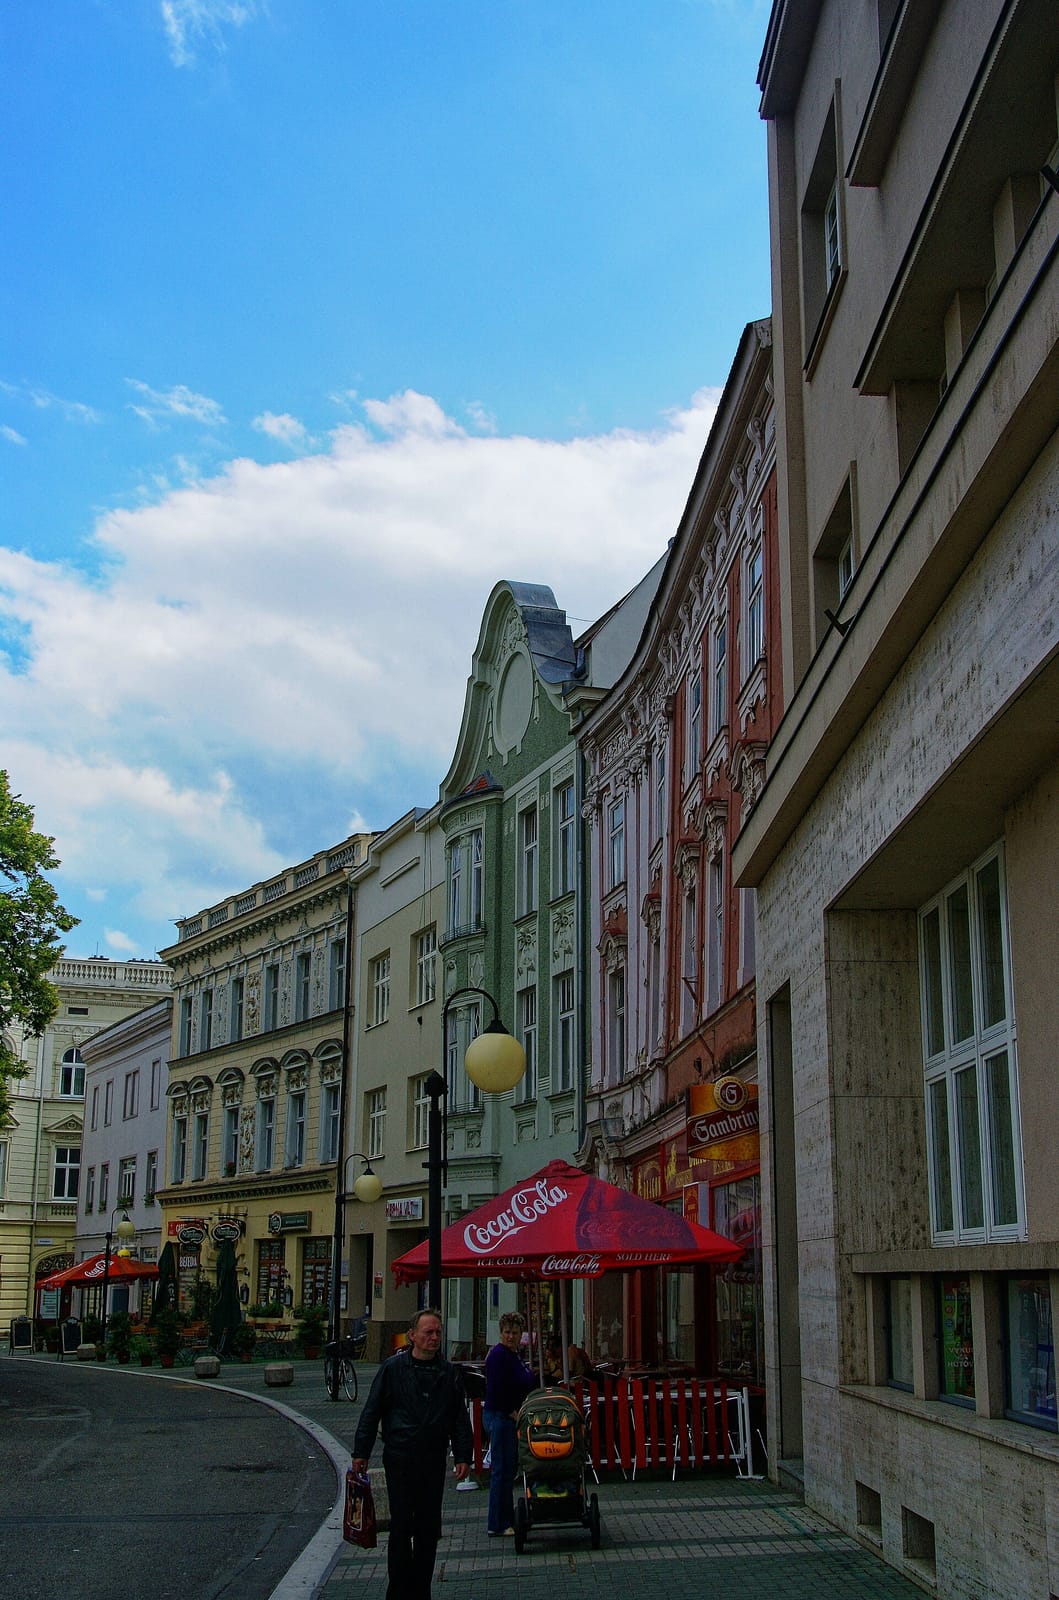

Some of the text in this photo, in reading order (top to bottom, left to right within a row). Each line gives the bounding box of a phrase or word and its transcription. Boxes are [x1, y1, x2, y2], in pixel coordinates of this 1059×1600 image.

[463, 1178, 568, 1254] Coca-Cola
[477, 1256, 525, 1267] ICE COLD
[541, 1254, 602, 1276] Coca-Cola
